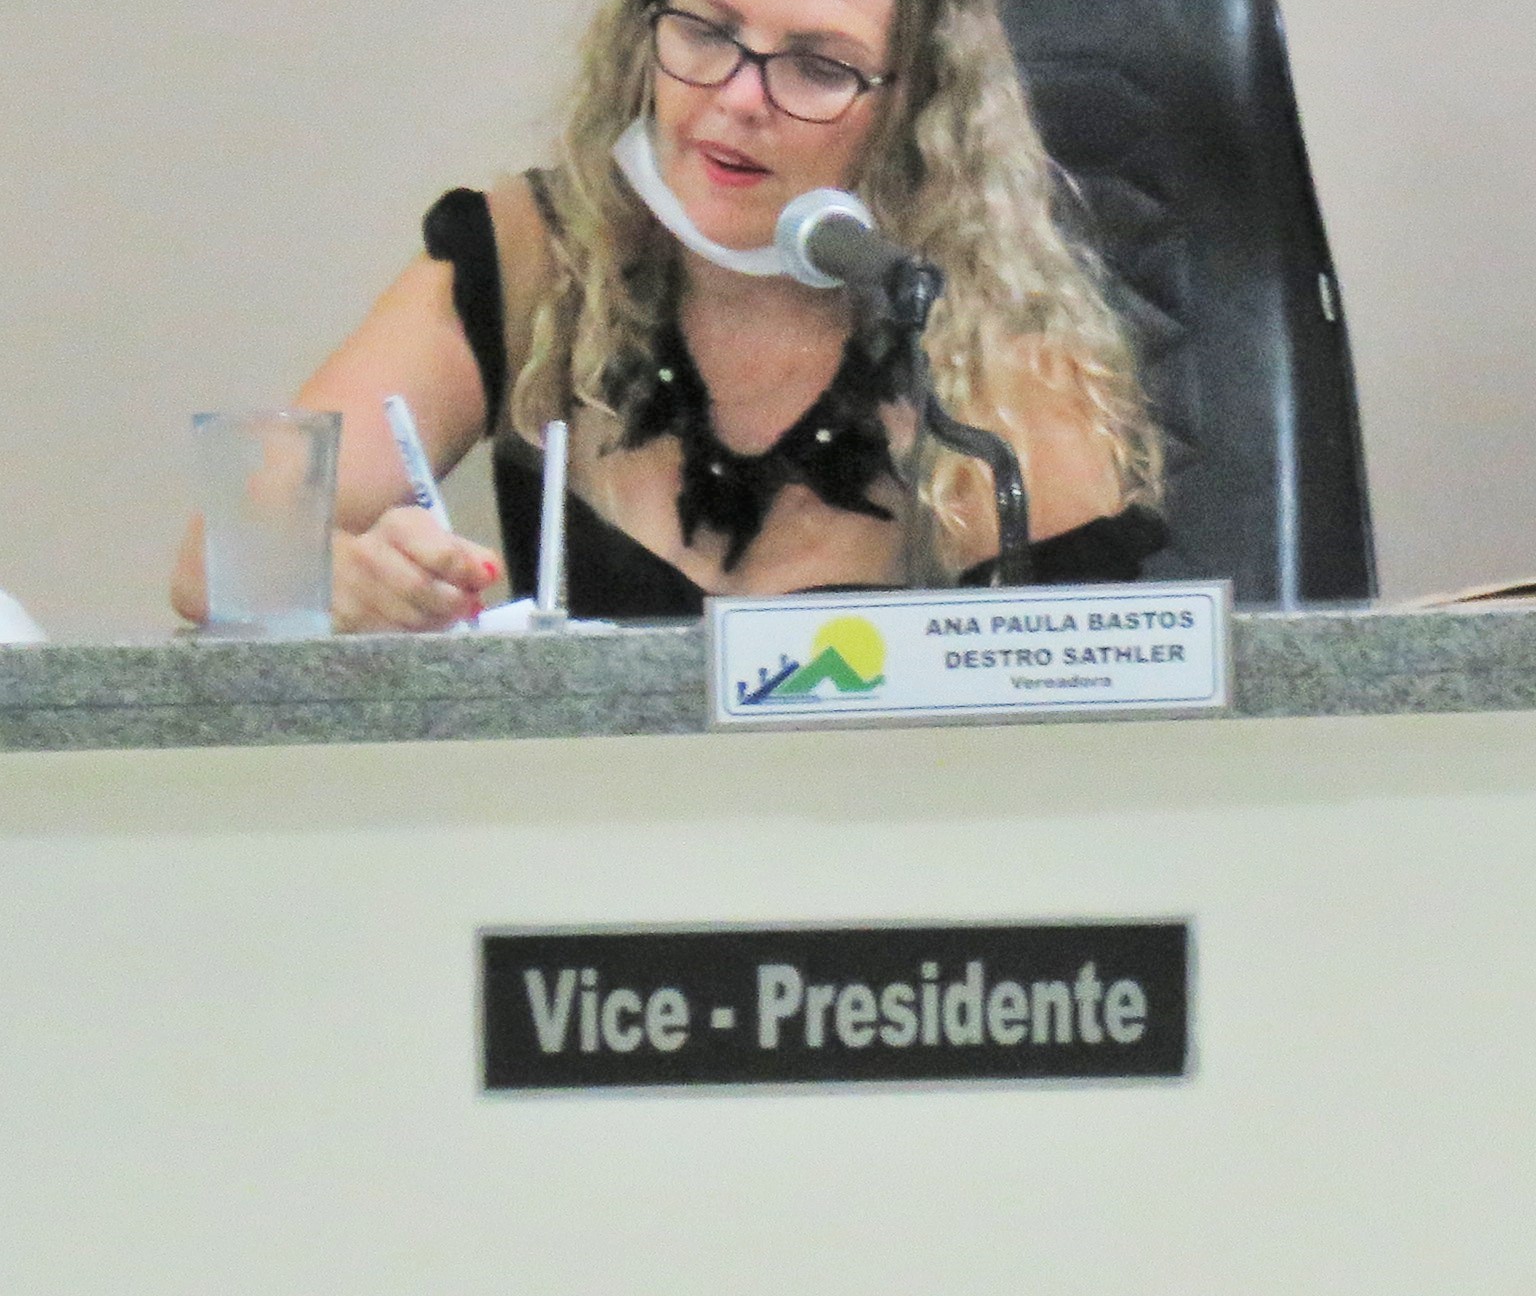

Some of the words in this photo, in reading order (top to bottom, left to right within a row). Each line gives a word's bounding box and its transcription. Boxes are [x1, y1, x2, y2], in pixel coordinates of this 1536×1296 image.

[925, 616, 981, 637] ANA
[991, 613, 1077, 635] PAULA
[1088, 610, 1195, 631] BASTOS
[944, 647, 1052, 670] DESTRO
[1062, 643, 1186, 666] SATHLER
[1010, 673, 1112, 691] Vereadora
[523, 966, 691, 1054] Vice
[709, 1007, 736, 1030] -
[756, 959, 1149, 1051] Presidente
